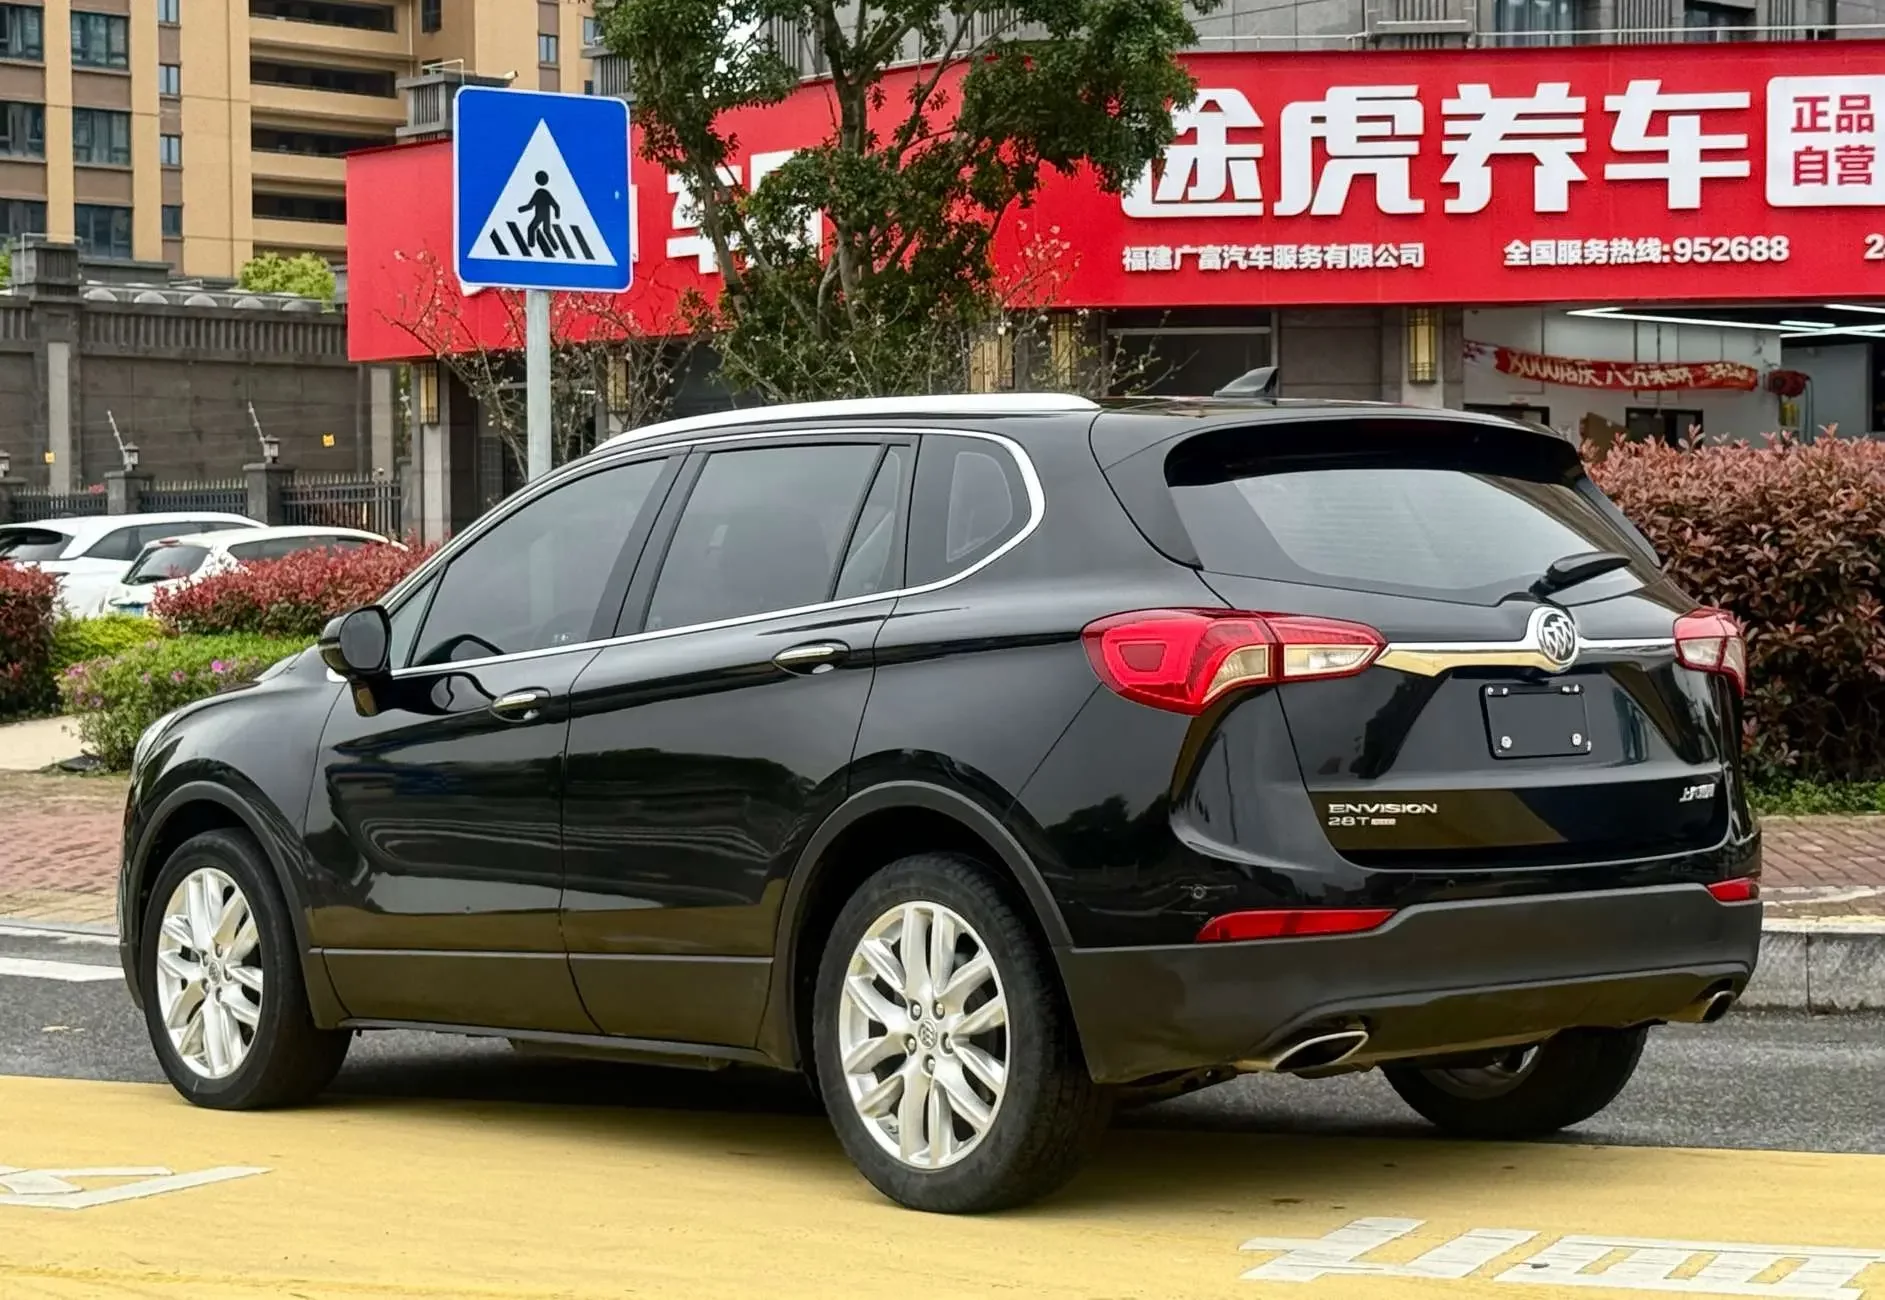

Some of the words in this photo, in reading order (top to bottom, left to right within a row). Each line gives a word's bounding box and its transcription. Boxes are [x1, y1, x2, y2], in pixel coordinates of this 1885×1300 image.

[1791, 94, 1874, 133] 正品
[1121, 79, 1751, 218] 途虎养车
[1792, 144, 1876, 186] 自营
[1122, 243, 1425, 272] 福建广富汽车服务有限公司
[1503, 235, 1790, 266] 全国服务热线:952688
[1328, 803, 1438, 814] ENVISION
[1328, 816, 1370, 826] 28T
